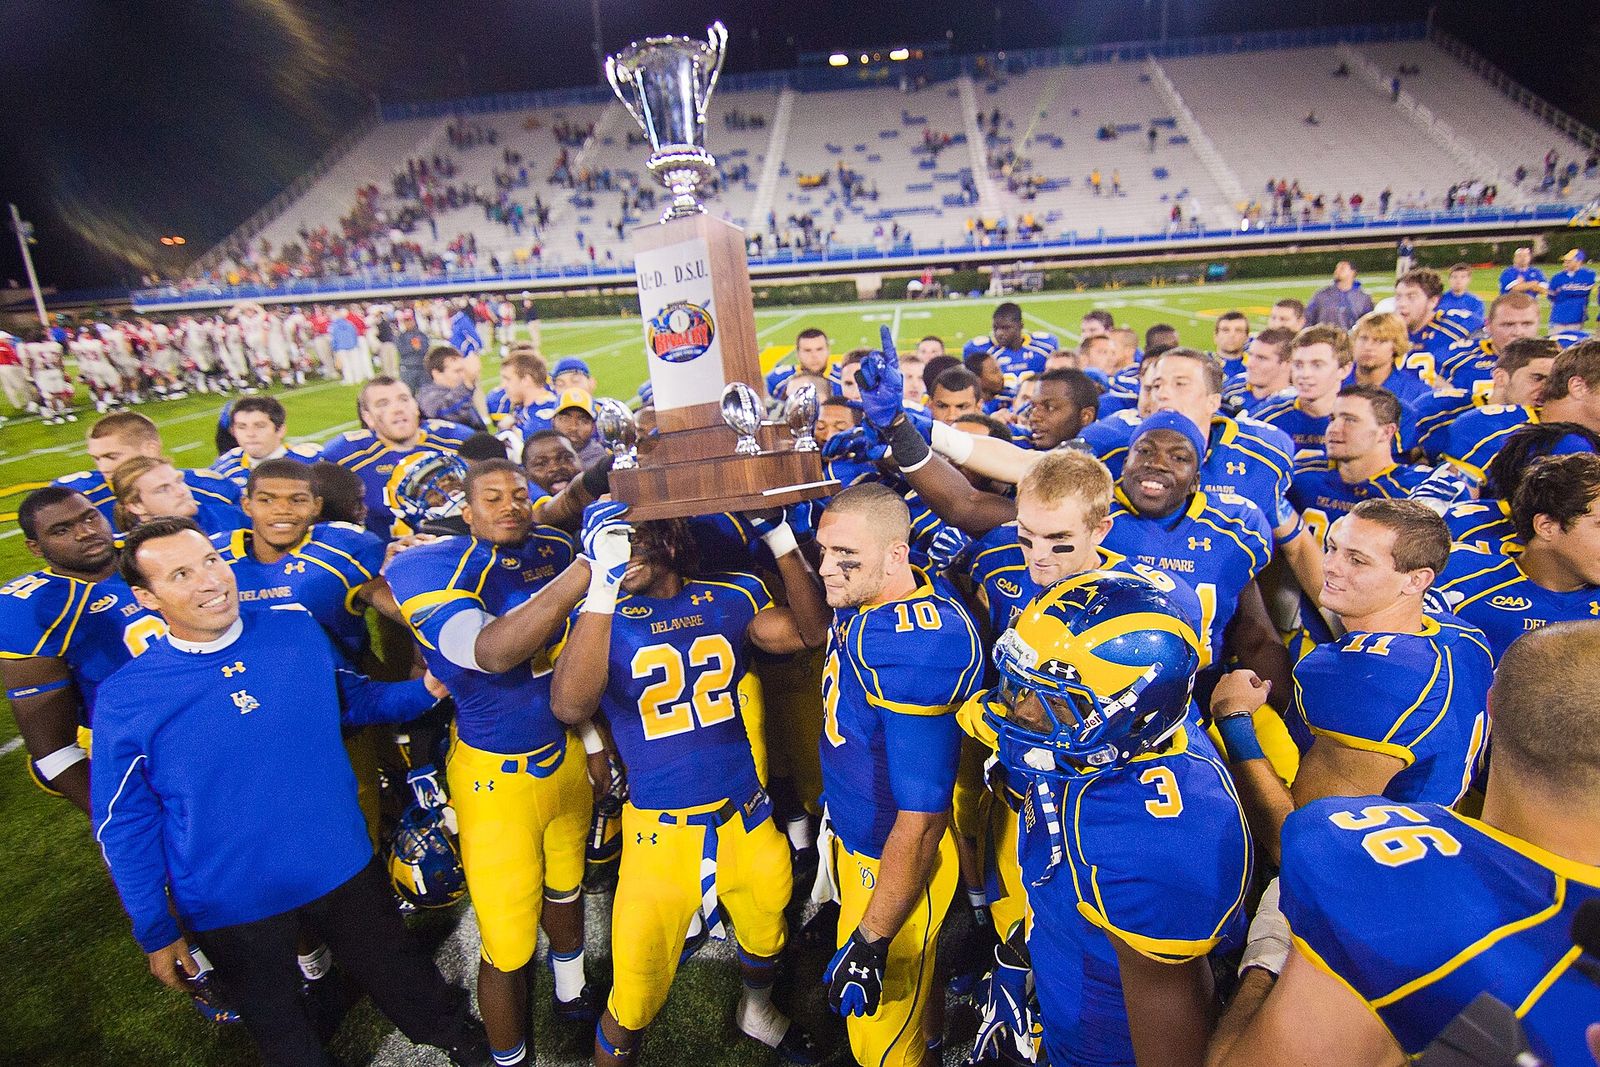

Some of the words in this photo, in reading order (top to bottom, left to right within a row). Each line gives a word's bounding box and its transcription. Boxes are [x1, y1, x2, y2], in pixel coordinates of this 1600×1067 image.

[674, 259, 709, 284] D.S.U.
[997, 578, 1019, 594] CAA
[621, 606, 649, 616] CAA
[1491, 595, 1526, 607] CAA
[650, 614, 704, 635] DELAWARE
[894, 601, 943, 633] 10
[1340, 633, 1397, 656] 11
[630, 633, 736, 742] 22
[1139, 765, 1184, 818] 3
[1327, 805, 1463, 868] 56
